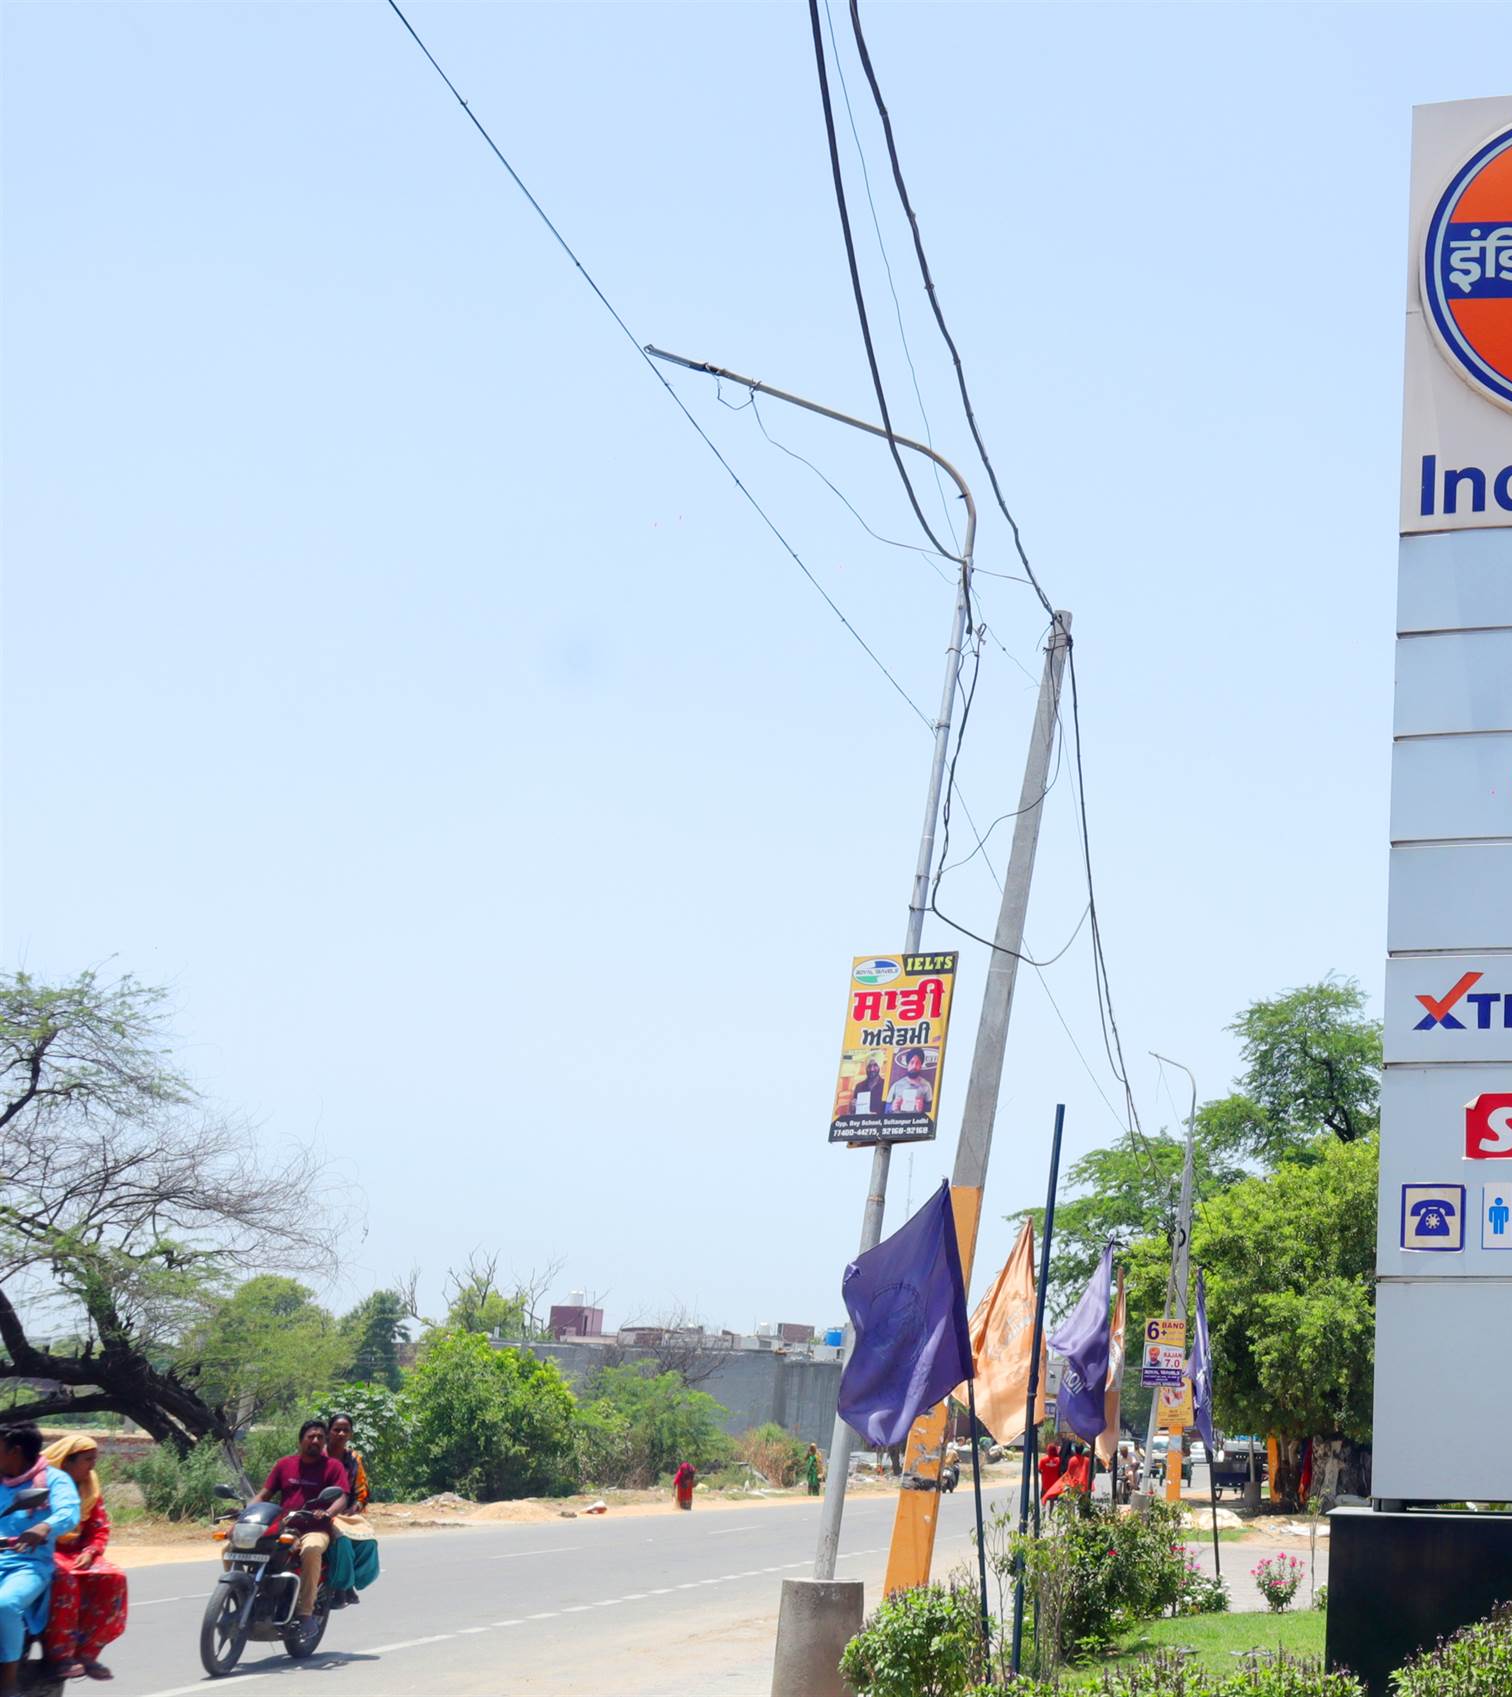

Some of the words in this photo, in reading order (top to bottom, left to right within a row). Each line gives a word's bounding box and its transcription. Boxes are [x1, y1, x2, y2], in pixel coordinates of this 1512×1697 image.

[906, 956, 953, 971] IELTS
[853, 978, 945, 1021] ਸਾਡੀ
[1164, 1359, 1180, 1368] 7.0
